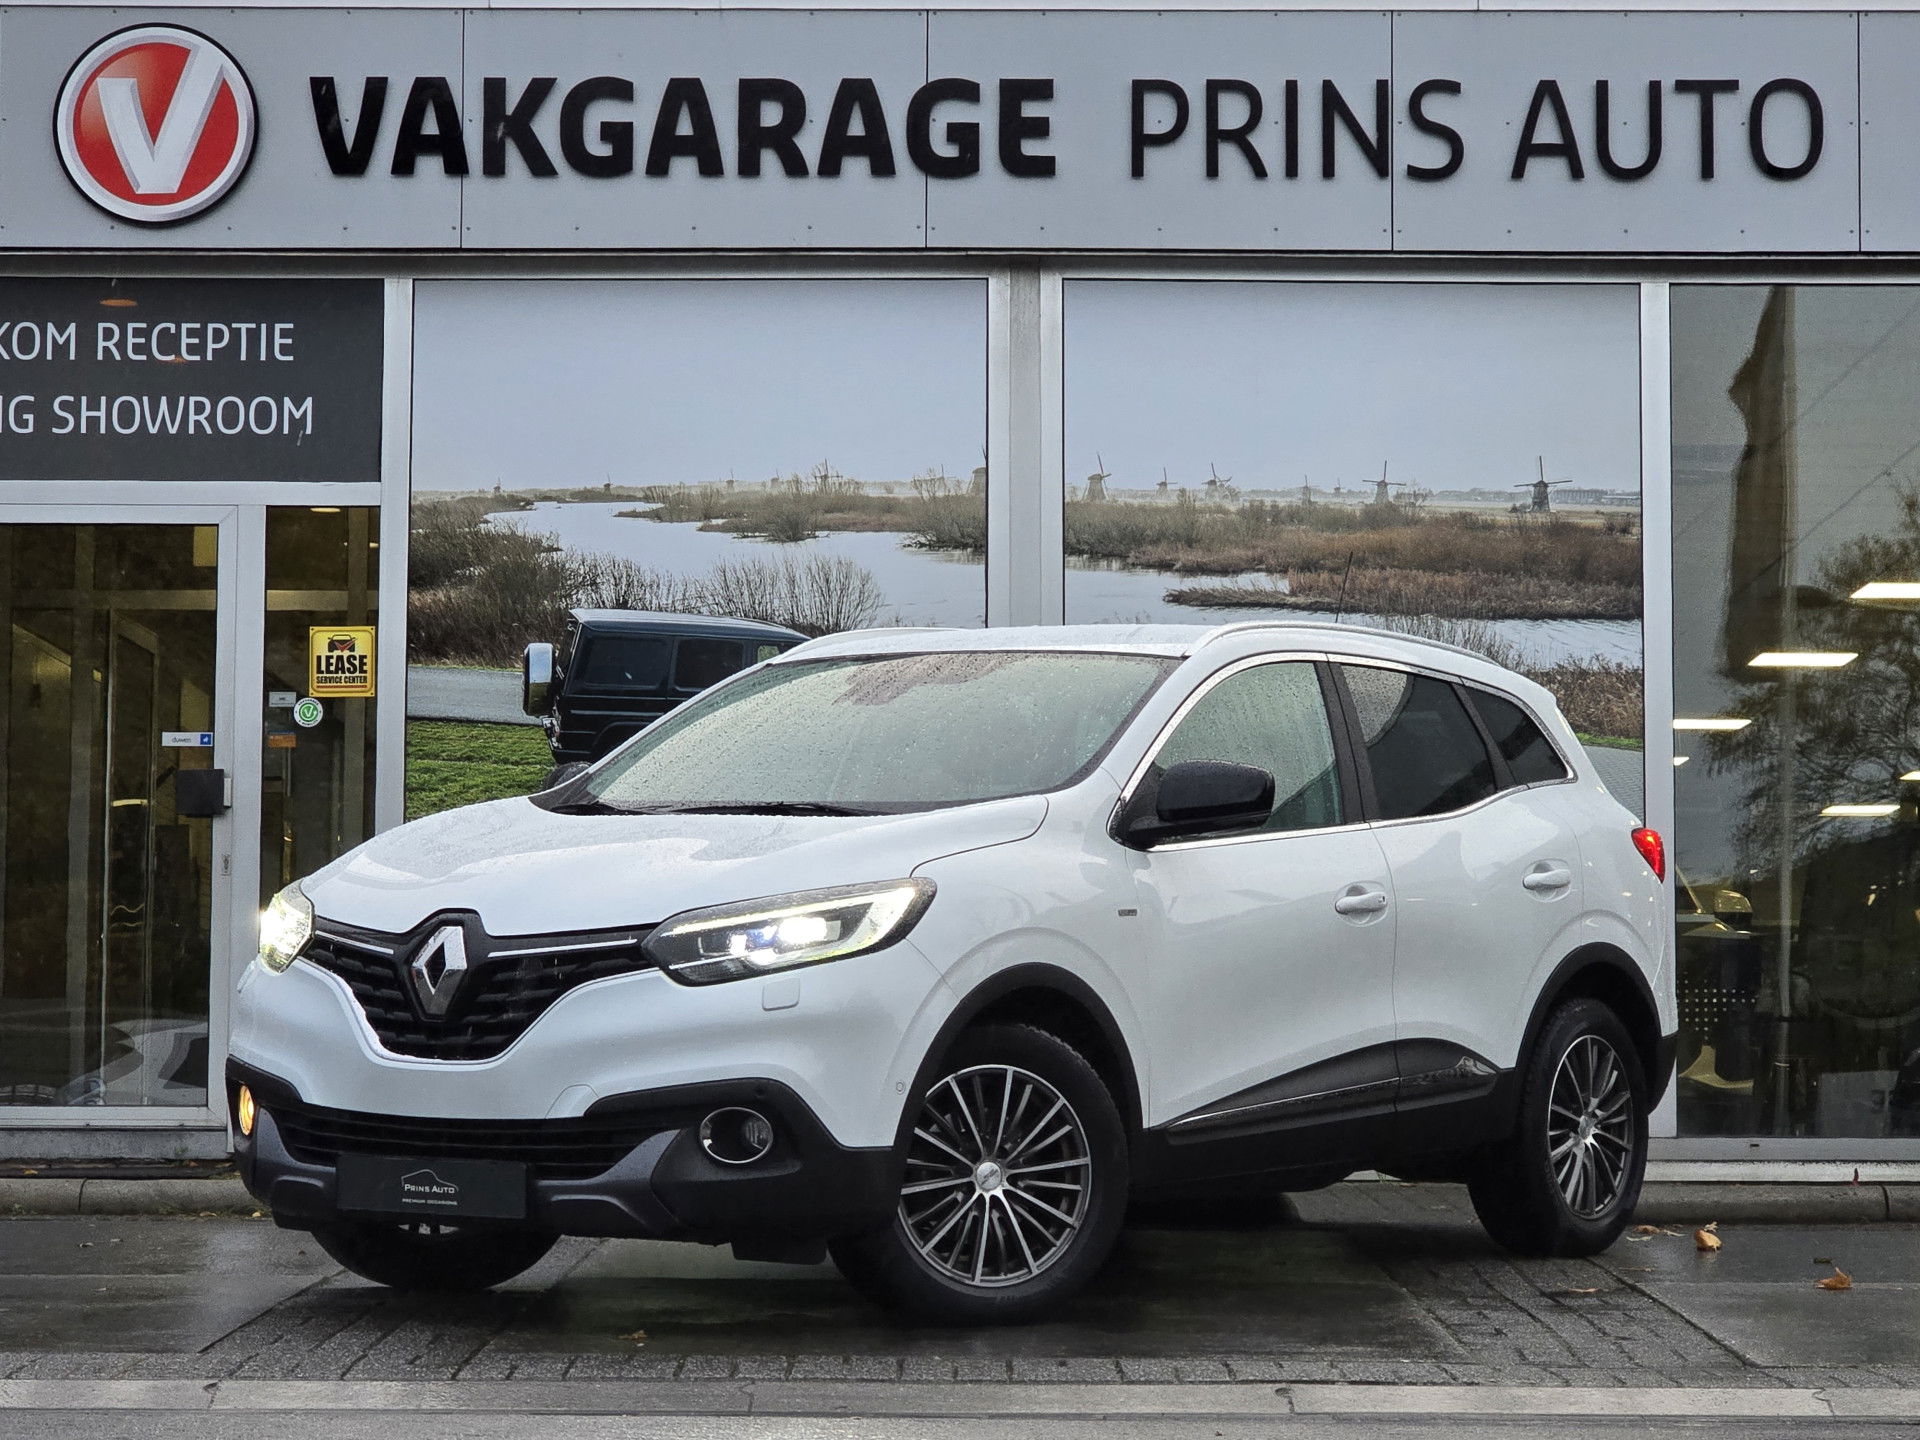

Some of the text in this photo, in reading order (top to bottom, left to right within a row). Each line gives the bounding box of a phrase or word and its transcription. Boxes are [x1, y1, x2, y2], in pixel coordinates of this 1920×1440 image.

[309, 75, 1824, 182] VAKGARAGE PRINS AUTO
[97, 322, 294, 362] RECEPTIE
[51, 395, 313, 435] SHOWROOM
[316, 654, 368, 675] LEASE
[316, 675, 368, 684] SERVICE CENTER
[404, 1184, 455, 1193] PRINS AUTO
